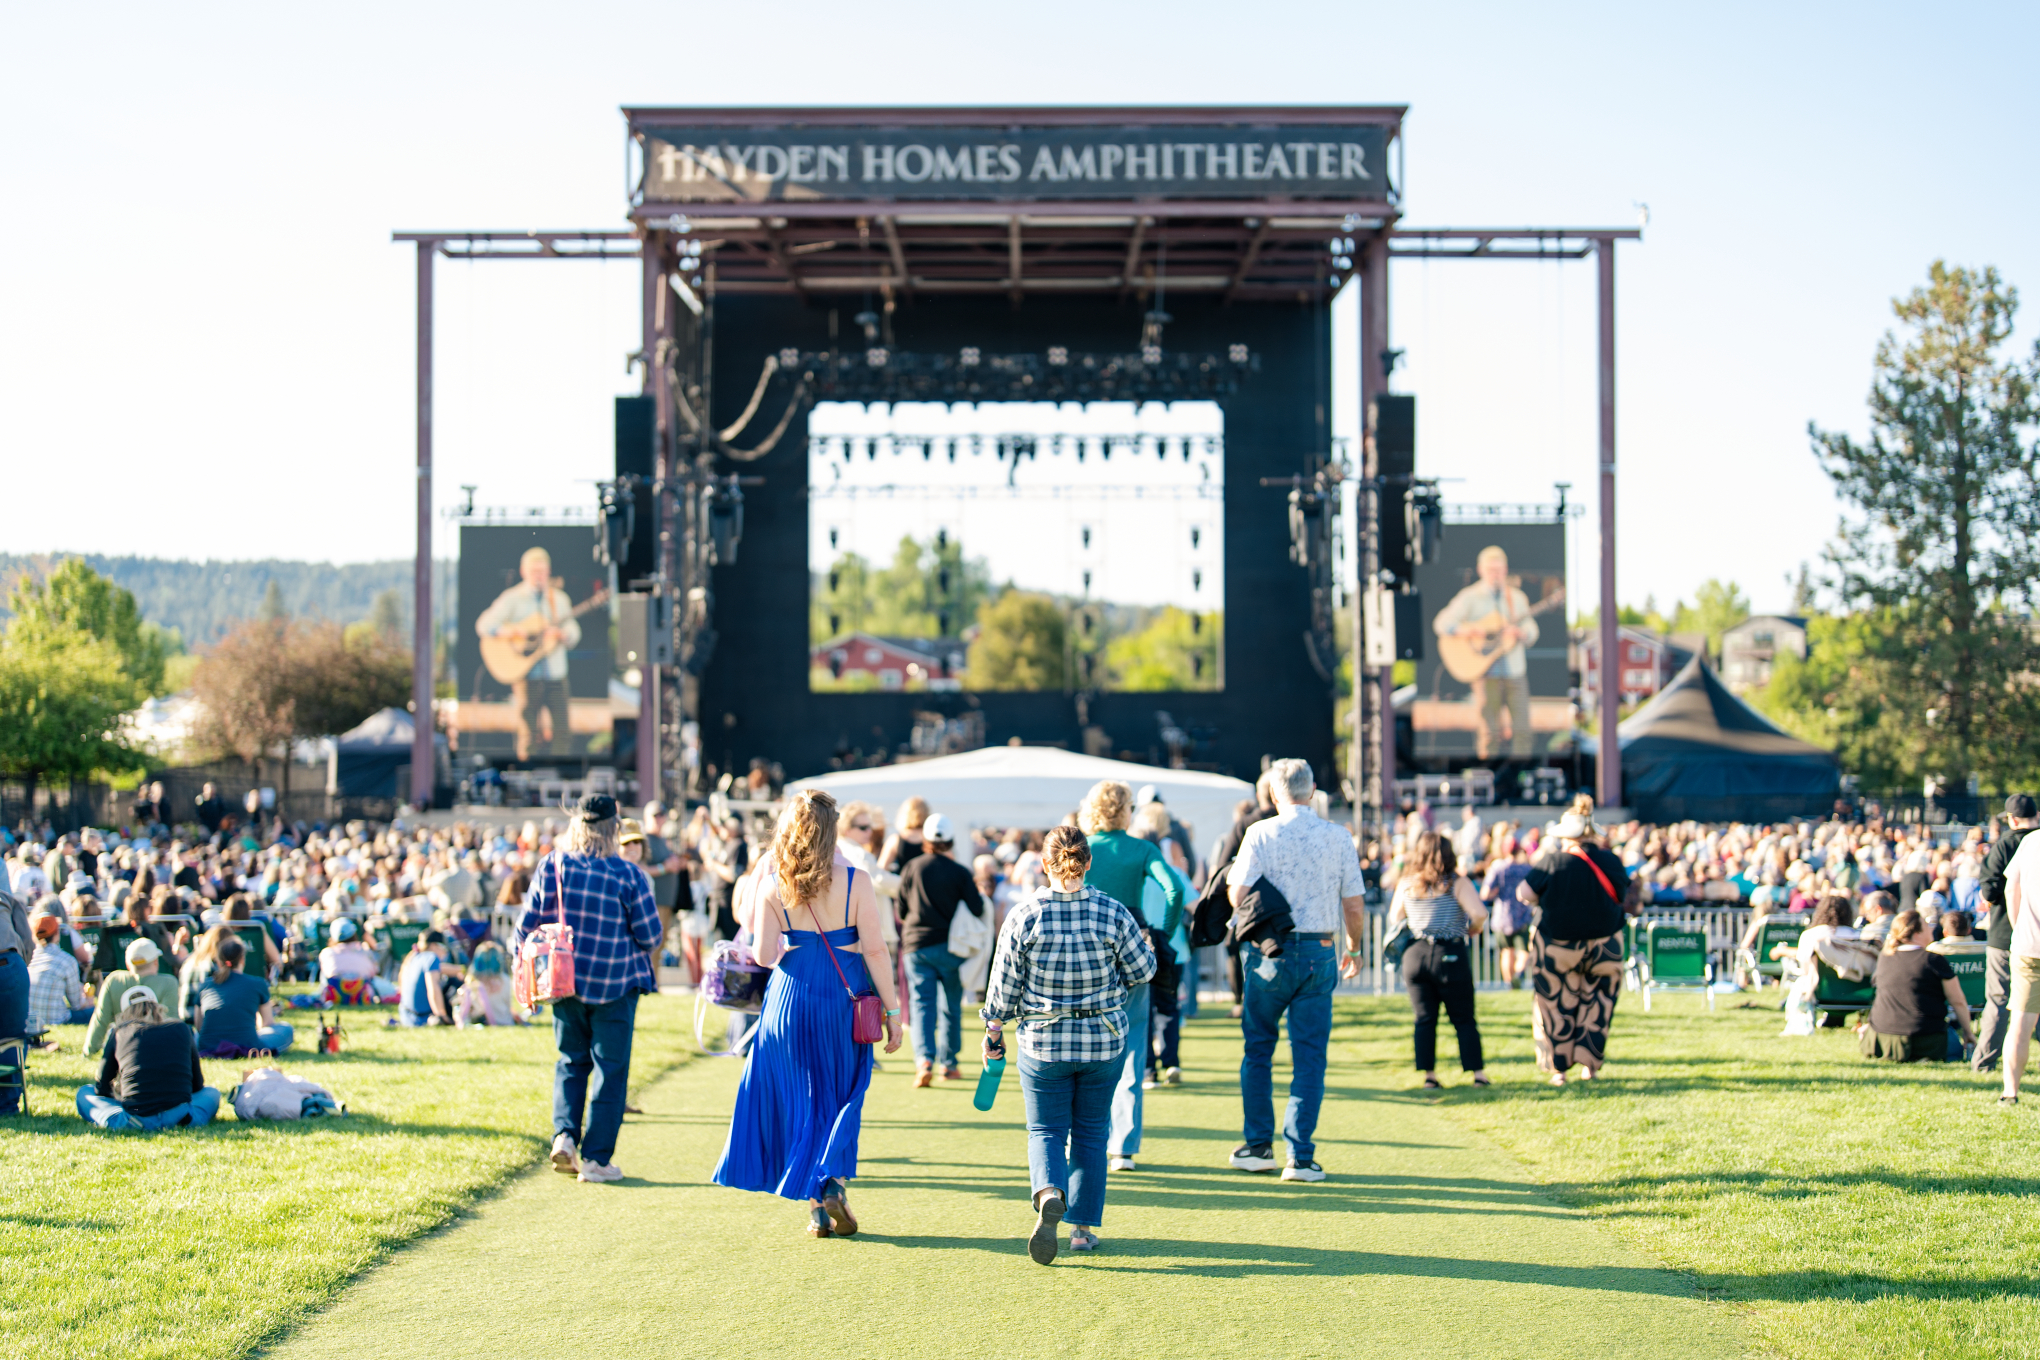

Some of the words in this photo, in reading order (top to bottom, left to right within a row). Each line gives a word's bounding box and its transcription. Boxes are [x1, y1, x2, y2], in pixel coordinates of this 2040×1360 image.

[657, 144, 850, 182] HAYDEN
[862, 144, 1022, 183] HOMES
[1028, 142, 1372, 182] AMPHITHEATER
[1657, 936, 1699, 949] RENTAL
